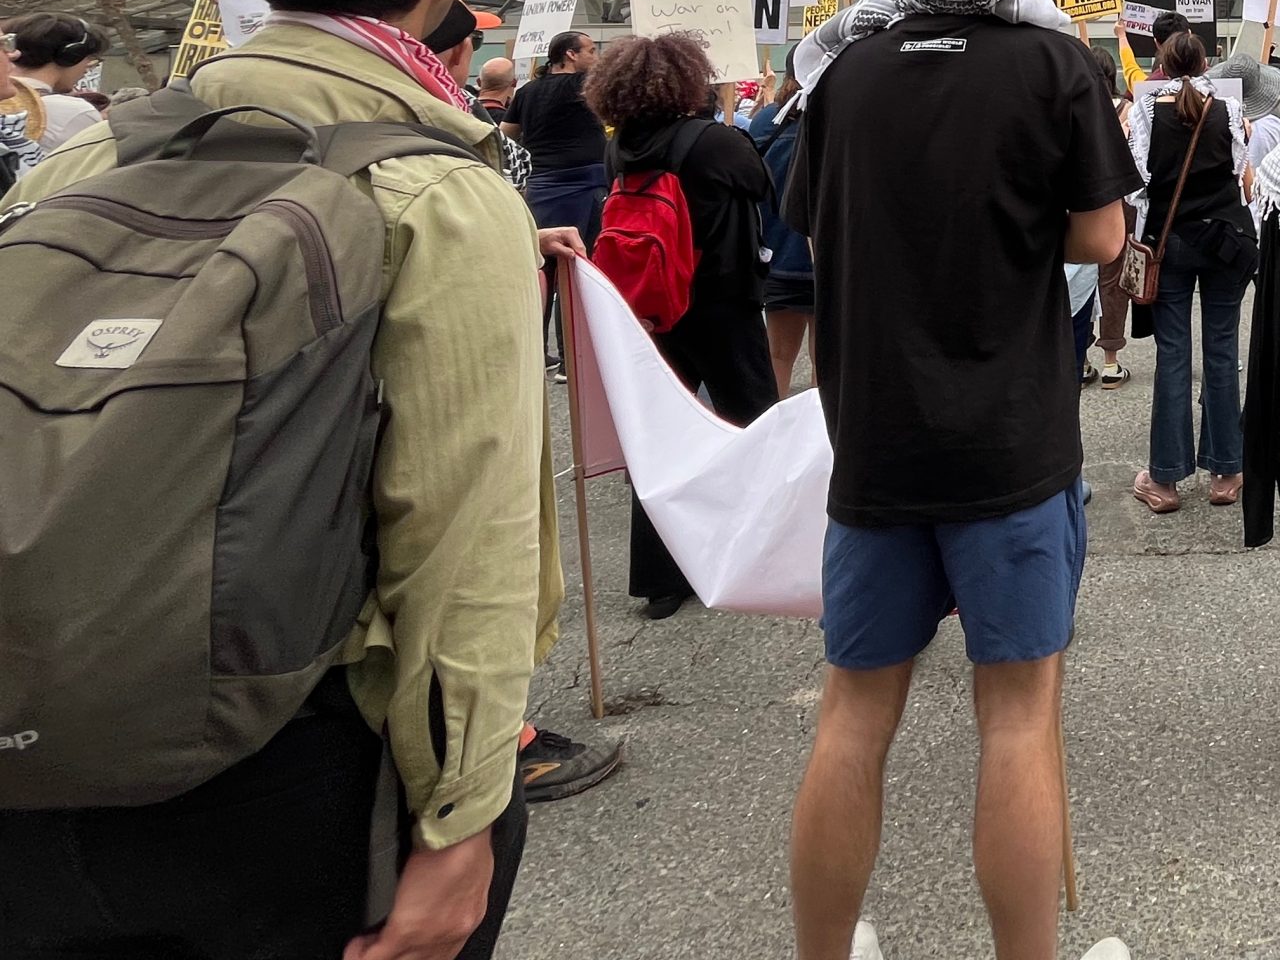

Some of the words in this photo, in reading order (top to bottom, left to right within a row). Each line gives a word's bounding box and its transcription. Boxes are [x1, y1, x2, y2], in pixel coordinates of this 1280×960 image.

[651, 2, 703, 18] War
[716, 4, 740, 14] on
[176, 43, 227, 74] IRA
[91, 326, 145, 338] OSPREY
